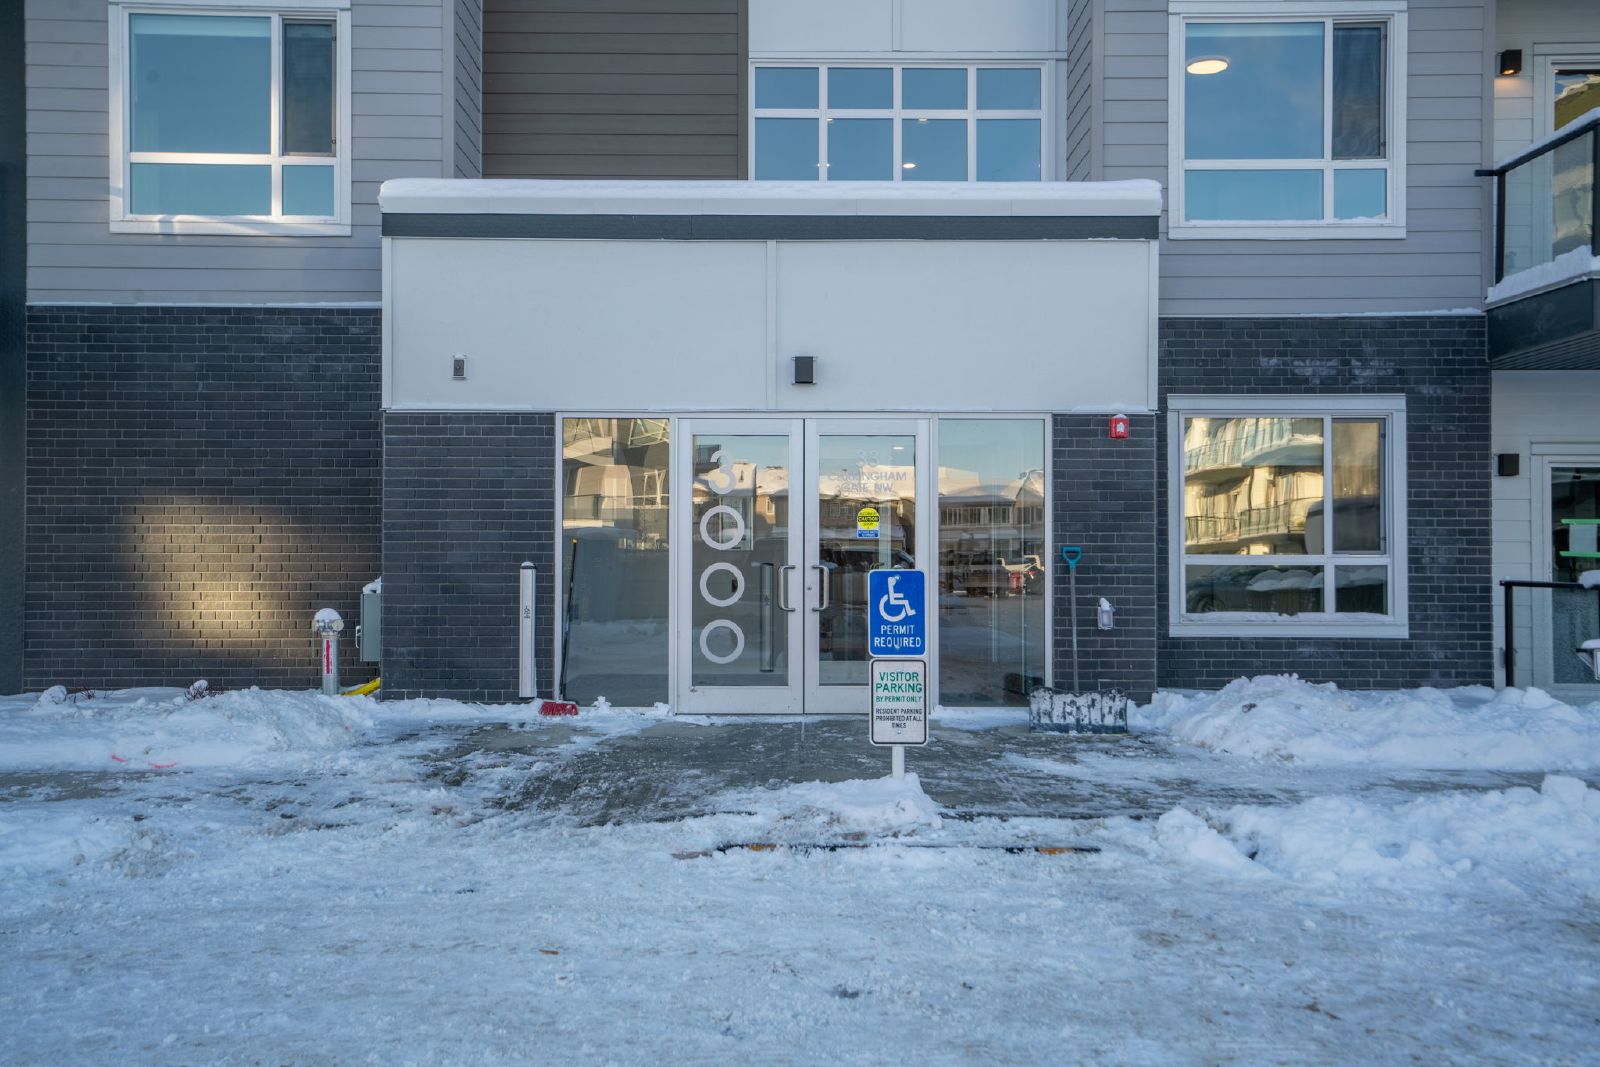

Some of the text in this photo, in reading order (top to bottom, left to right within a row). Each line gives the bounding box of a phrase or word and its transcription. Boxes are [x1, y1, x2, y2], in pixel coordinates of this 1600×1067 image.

[880, 625, 915, 635] PERMIT
[874, 637, 921, 648] REQUIRED
[879, 672, 919, 681] VISITOR
[876, 683, 922, 693] PARKING
